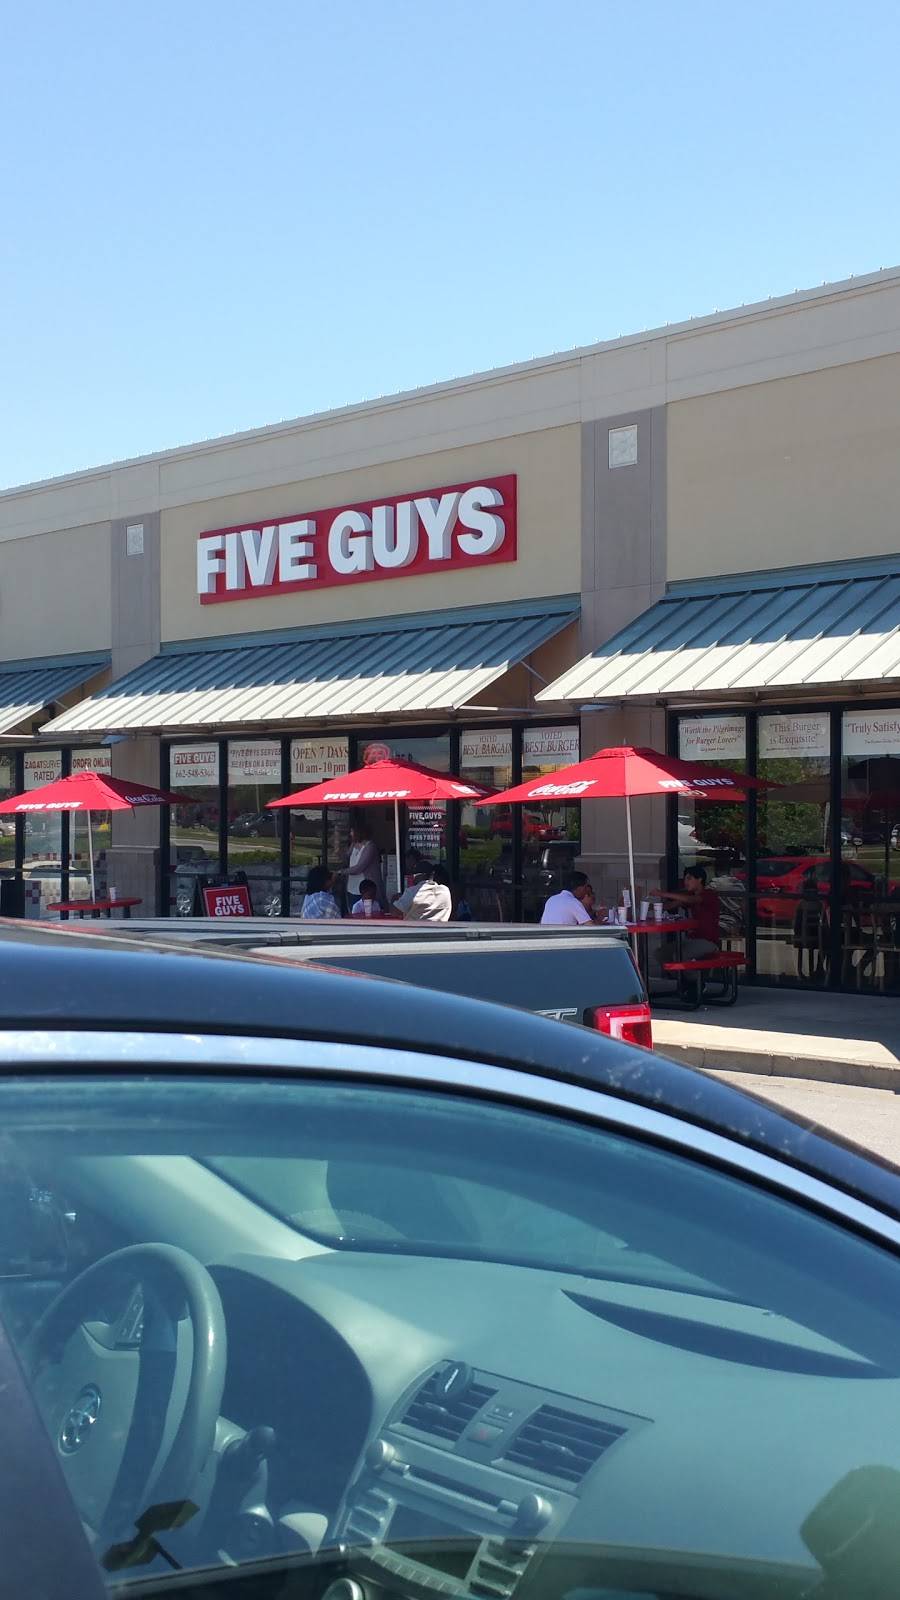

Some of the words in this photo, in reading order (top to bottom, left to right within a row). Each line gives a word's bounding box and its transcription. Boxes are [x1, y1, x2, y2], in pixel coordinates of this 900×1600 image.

[197, 519, 318, 594] FIVE
[328, 486, 505, 575] GUYS
[480, 735, 498, 743] VOTED
[541, 730, 562, 740] VOTED
[463, 744, 479, 755] BEST
[481, 743, 512, 755] BARGAIN
[525, 741, 546, 753] BEST
[547, 739, 579, 752] BURGER
[175, 753, 193, 764] FIVE
[193, 751, 215, 763] GUYS
[292, 746, 317, 760] OPEN
[320, 746, 325, 759] 7
[327, 745, 348, 758] DAYS
[25, 760, 61, 769] ZAGATSURVE
[73, 758, 92, 768] ORDER
[296, 762, 304, 773] 10
[33, 770, 55, 781] RATED
[658, 779, 693, 789] FIVE
[693, 778, 735, 786] GUYS
[322, 792, 361, 801] FIVE
[363, 790, 411, 799] GUYS
[15, 802, 44, 811] FIVE
[46, 801, 84, 809] GUYS
[409, 812, 424, 820] FIVE
[424, 812, 442, 820] GUYS
[215, 895, 241, 906] FIVE
[214, 904, 245, 916] GUYS
